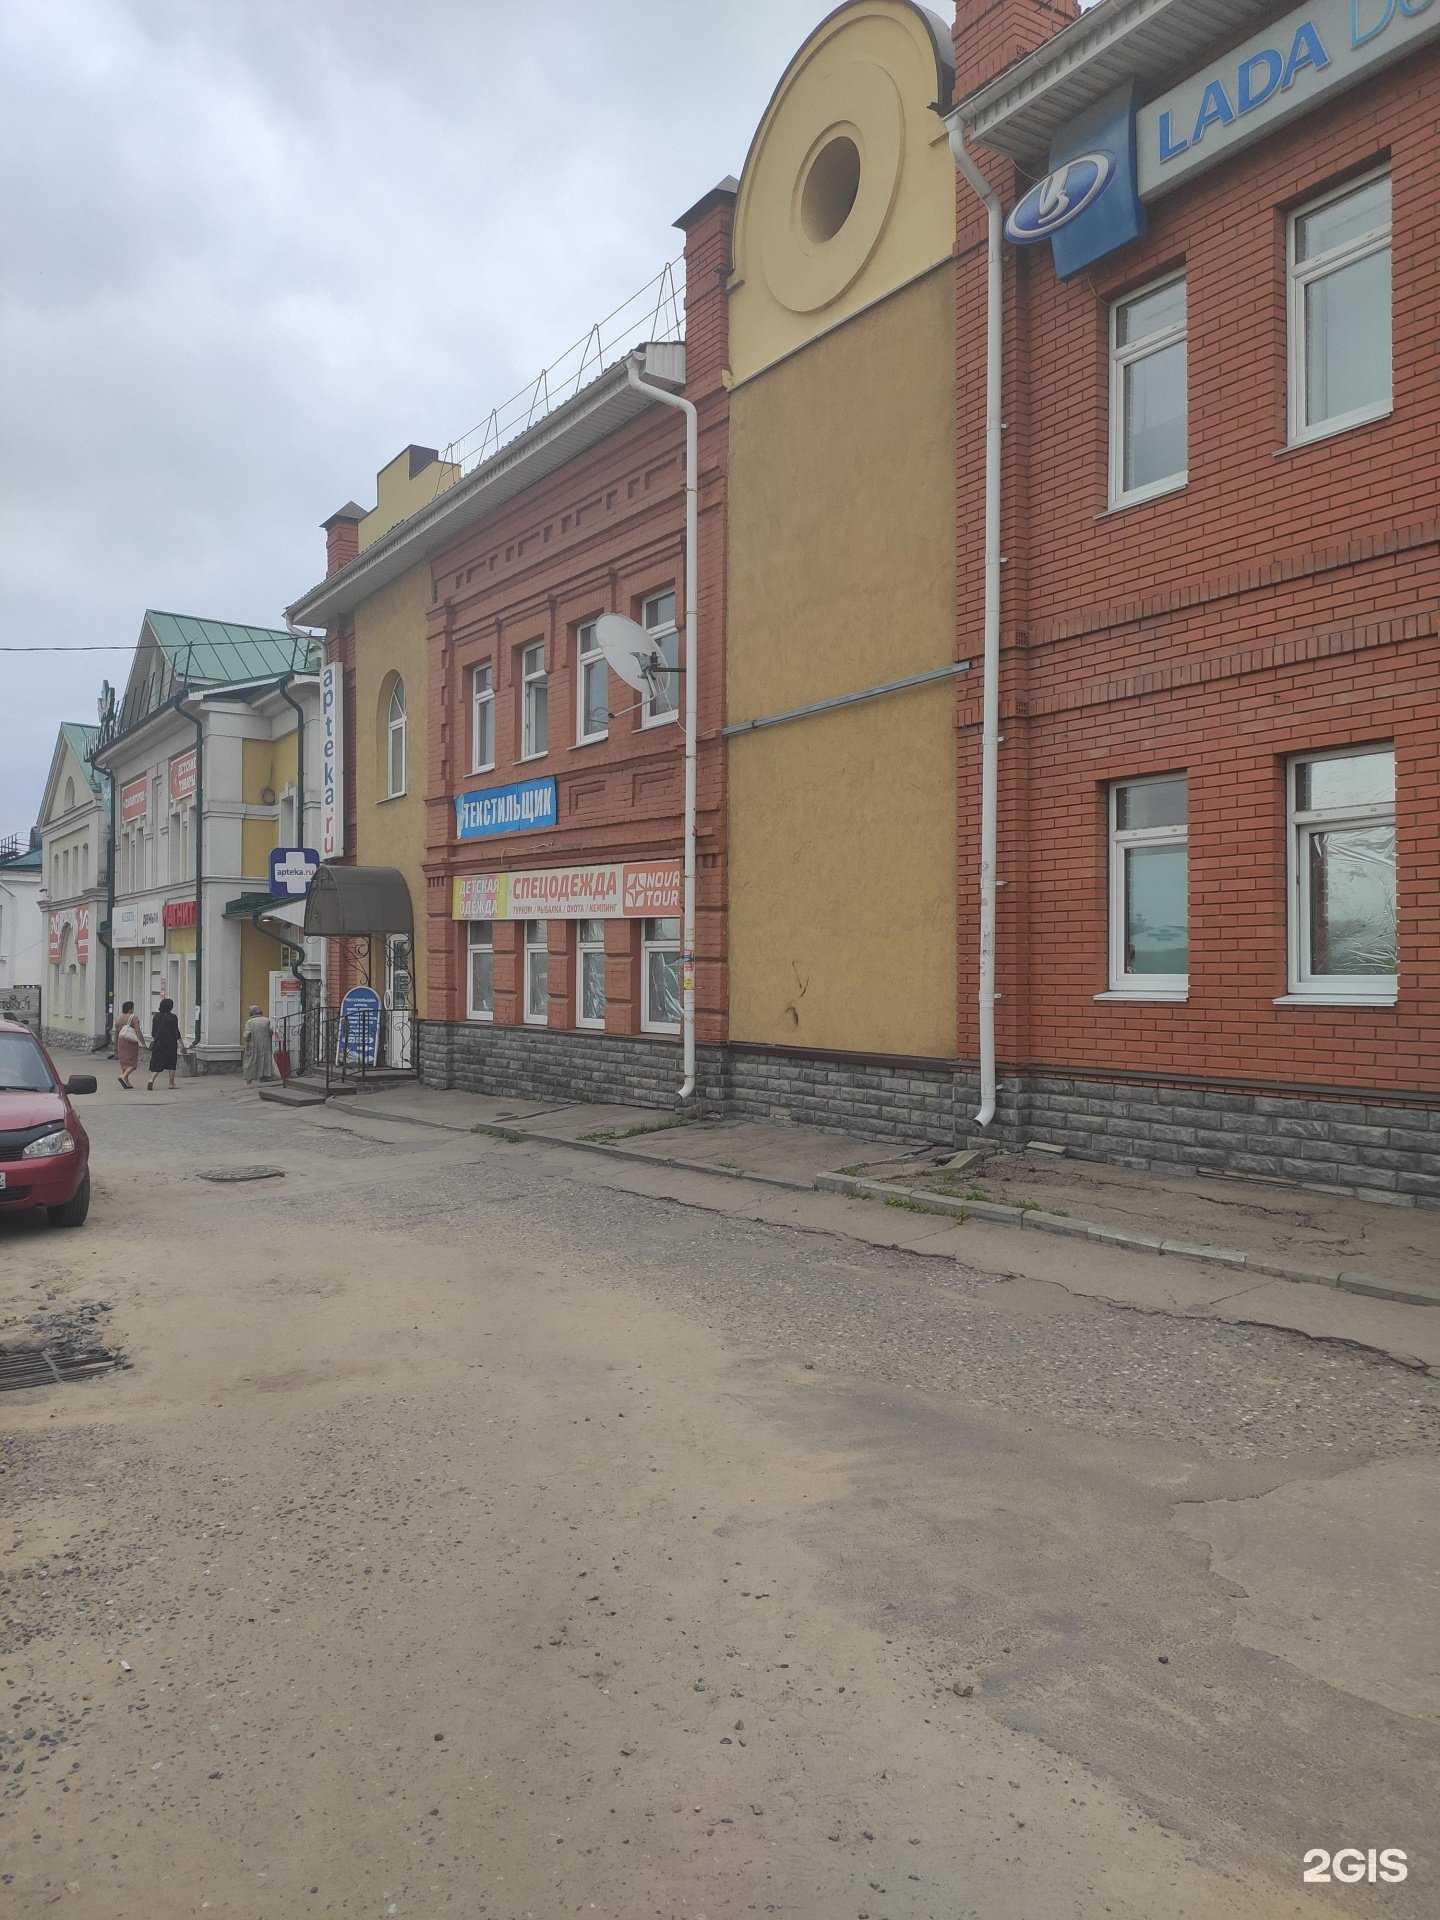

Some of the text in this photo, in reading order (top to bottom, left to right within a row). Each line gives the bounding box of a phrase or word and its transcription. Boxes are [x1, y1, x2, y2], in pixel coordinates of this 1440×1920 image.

[1159, 21, 1330, 165] LADA
[323, 668, 334, 854] apteka.ru
[463, 787, 552, 828] ТЕКСТИЛЬЩИК
[276, 869, 314, 877] apteka.ru
[646, 871, 680, 888] NOVA
[459, 878, 500, 897] ДЕТСКАЯ
[512, 871, 617, 902] СПЕЦОДЕЖДА
[459, 898, 499, 917] ОДЕЖДА
[646, 890, 679, 906] TOUR
